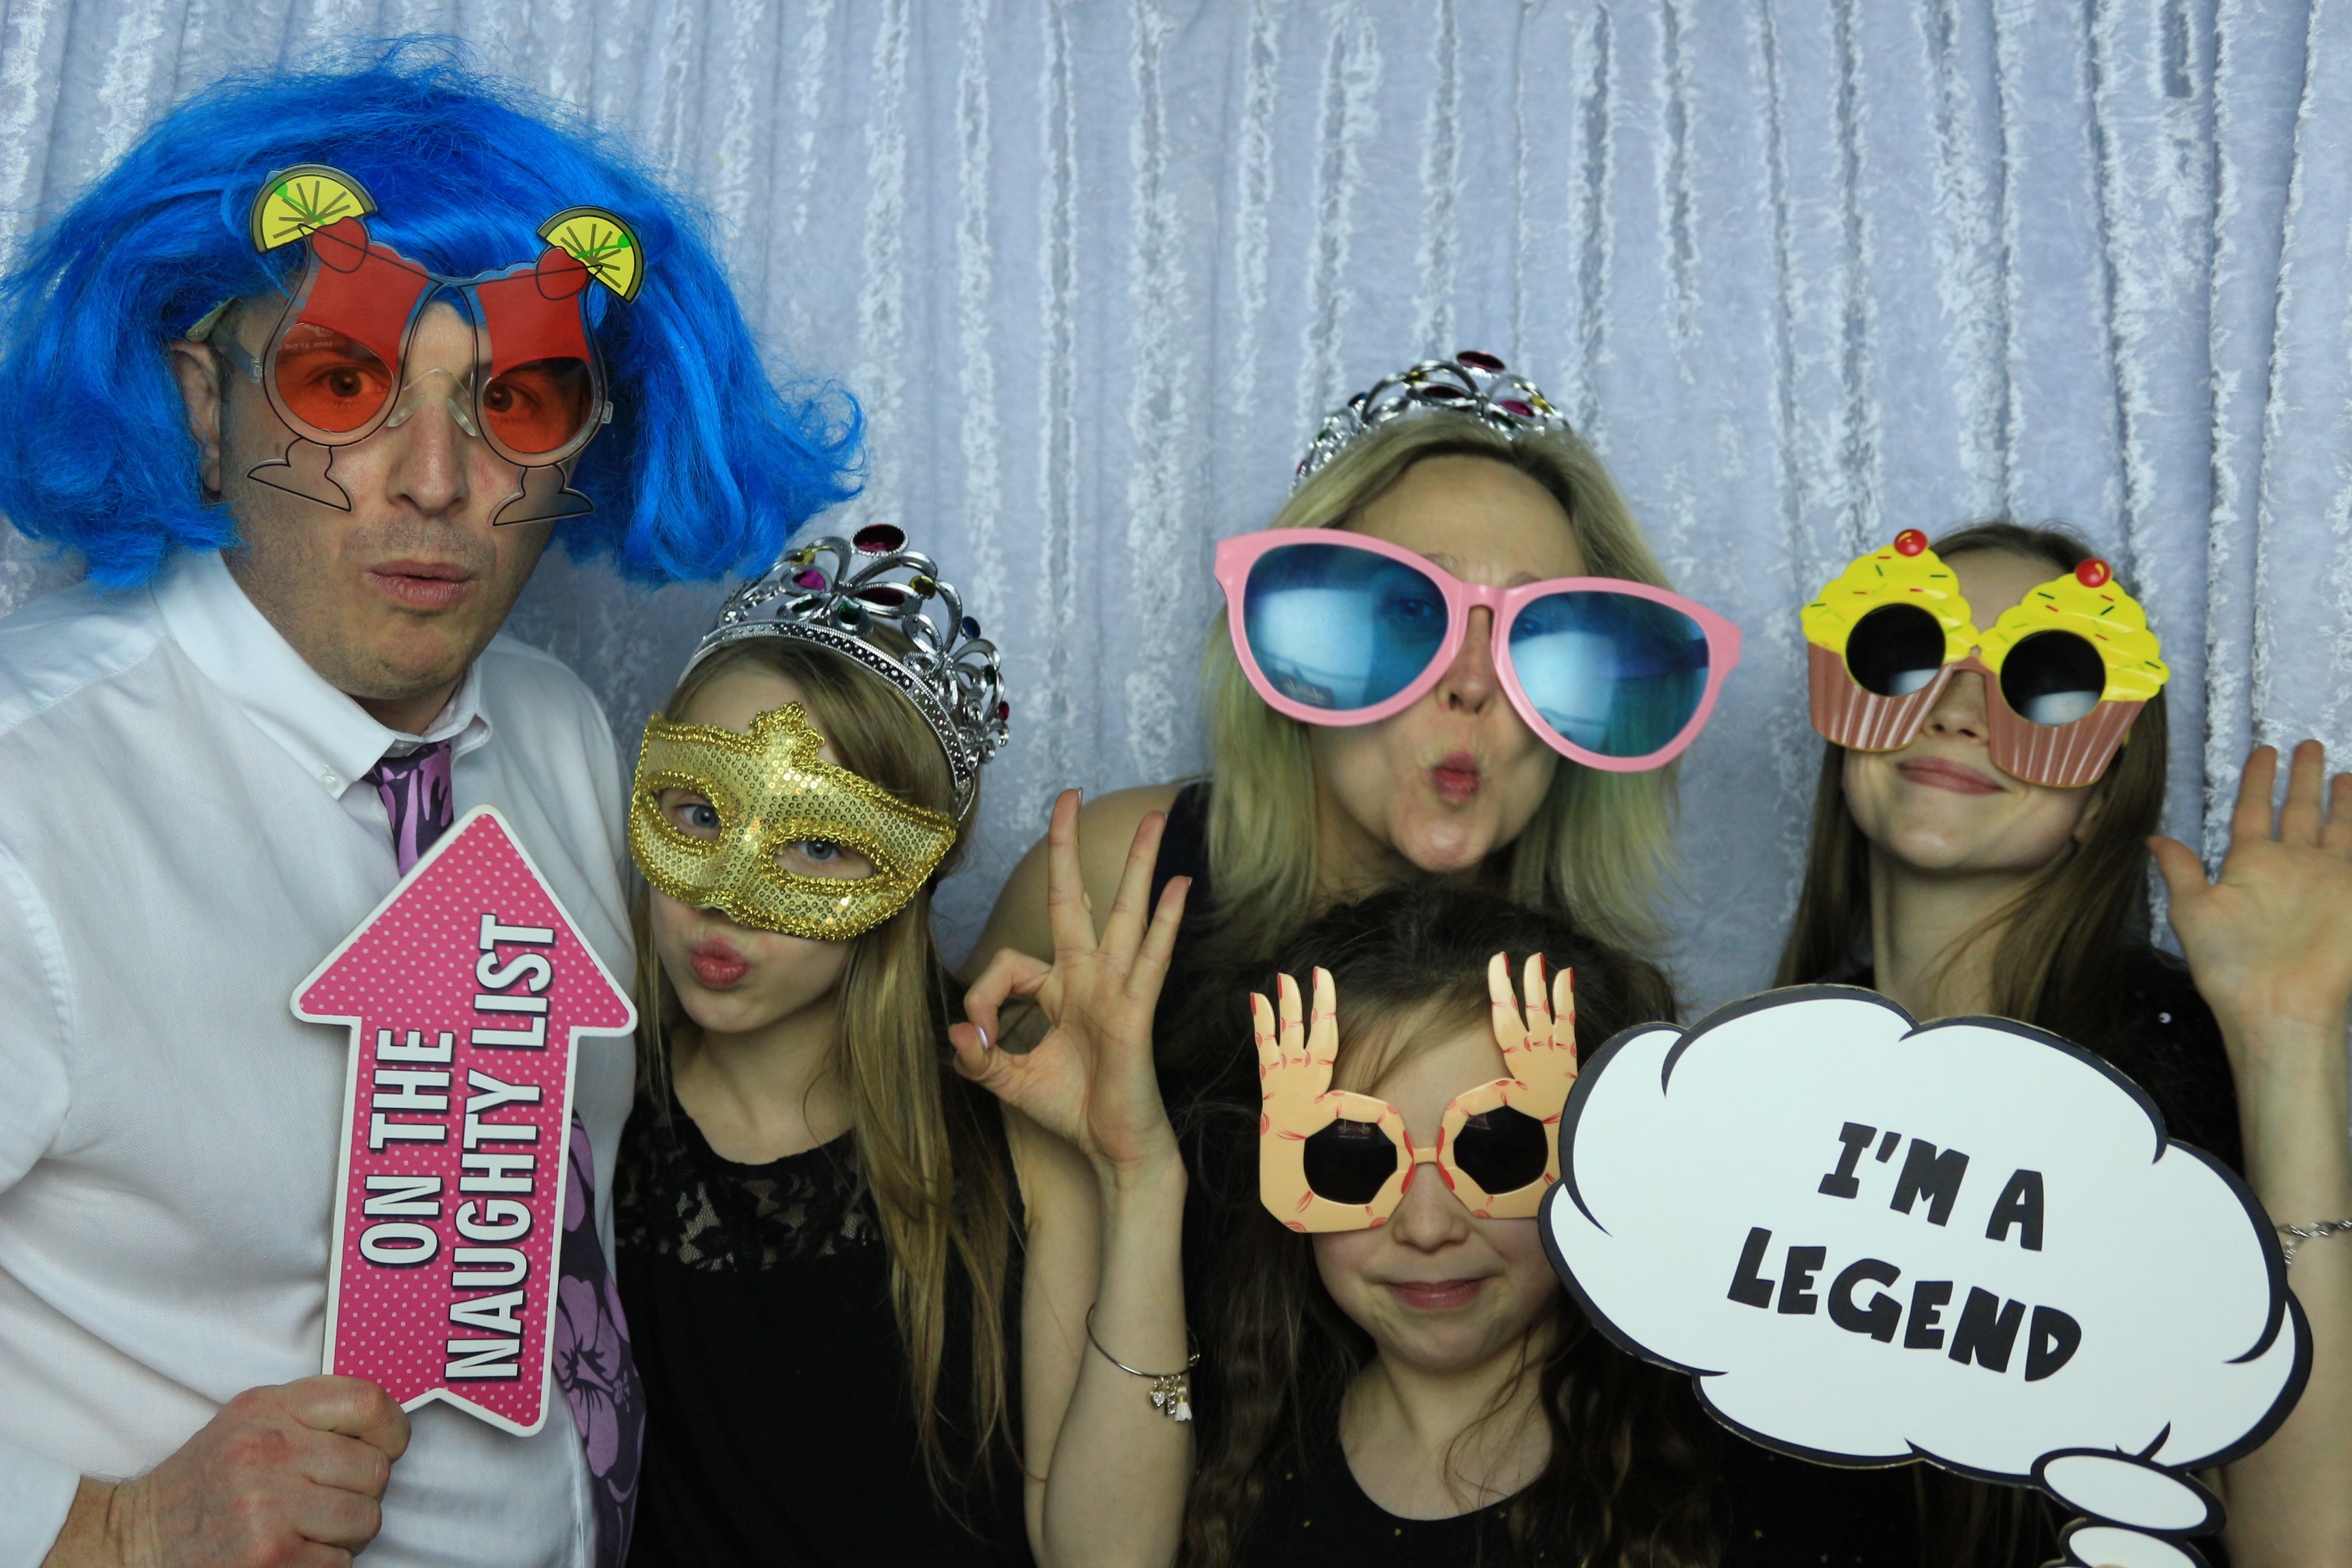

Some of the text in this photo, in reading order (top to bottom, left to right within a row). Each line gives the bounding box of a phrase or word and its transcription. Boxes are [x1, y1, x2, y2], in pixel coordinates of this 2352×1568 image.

[359, 1028, 455, 1269] ON THE
[444, 913, 555, 1381] NAUGHTY LIST
[1818, 1122, 2044, 1252] I'M A
[1727, 1227, 2082, 1382] LEGEND
